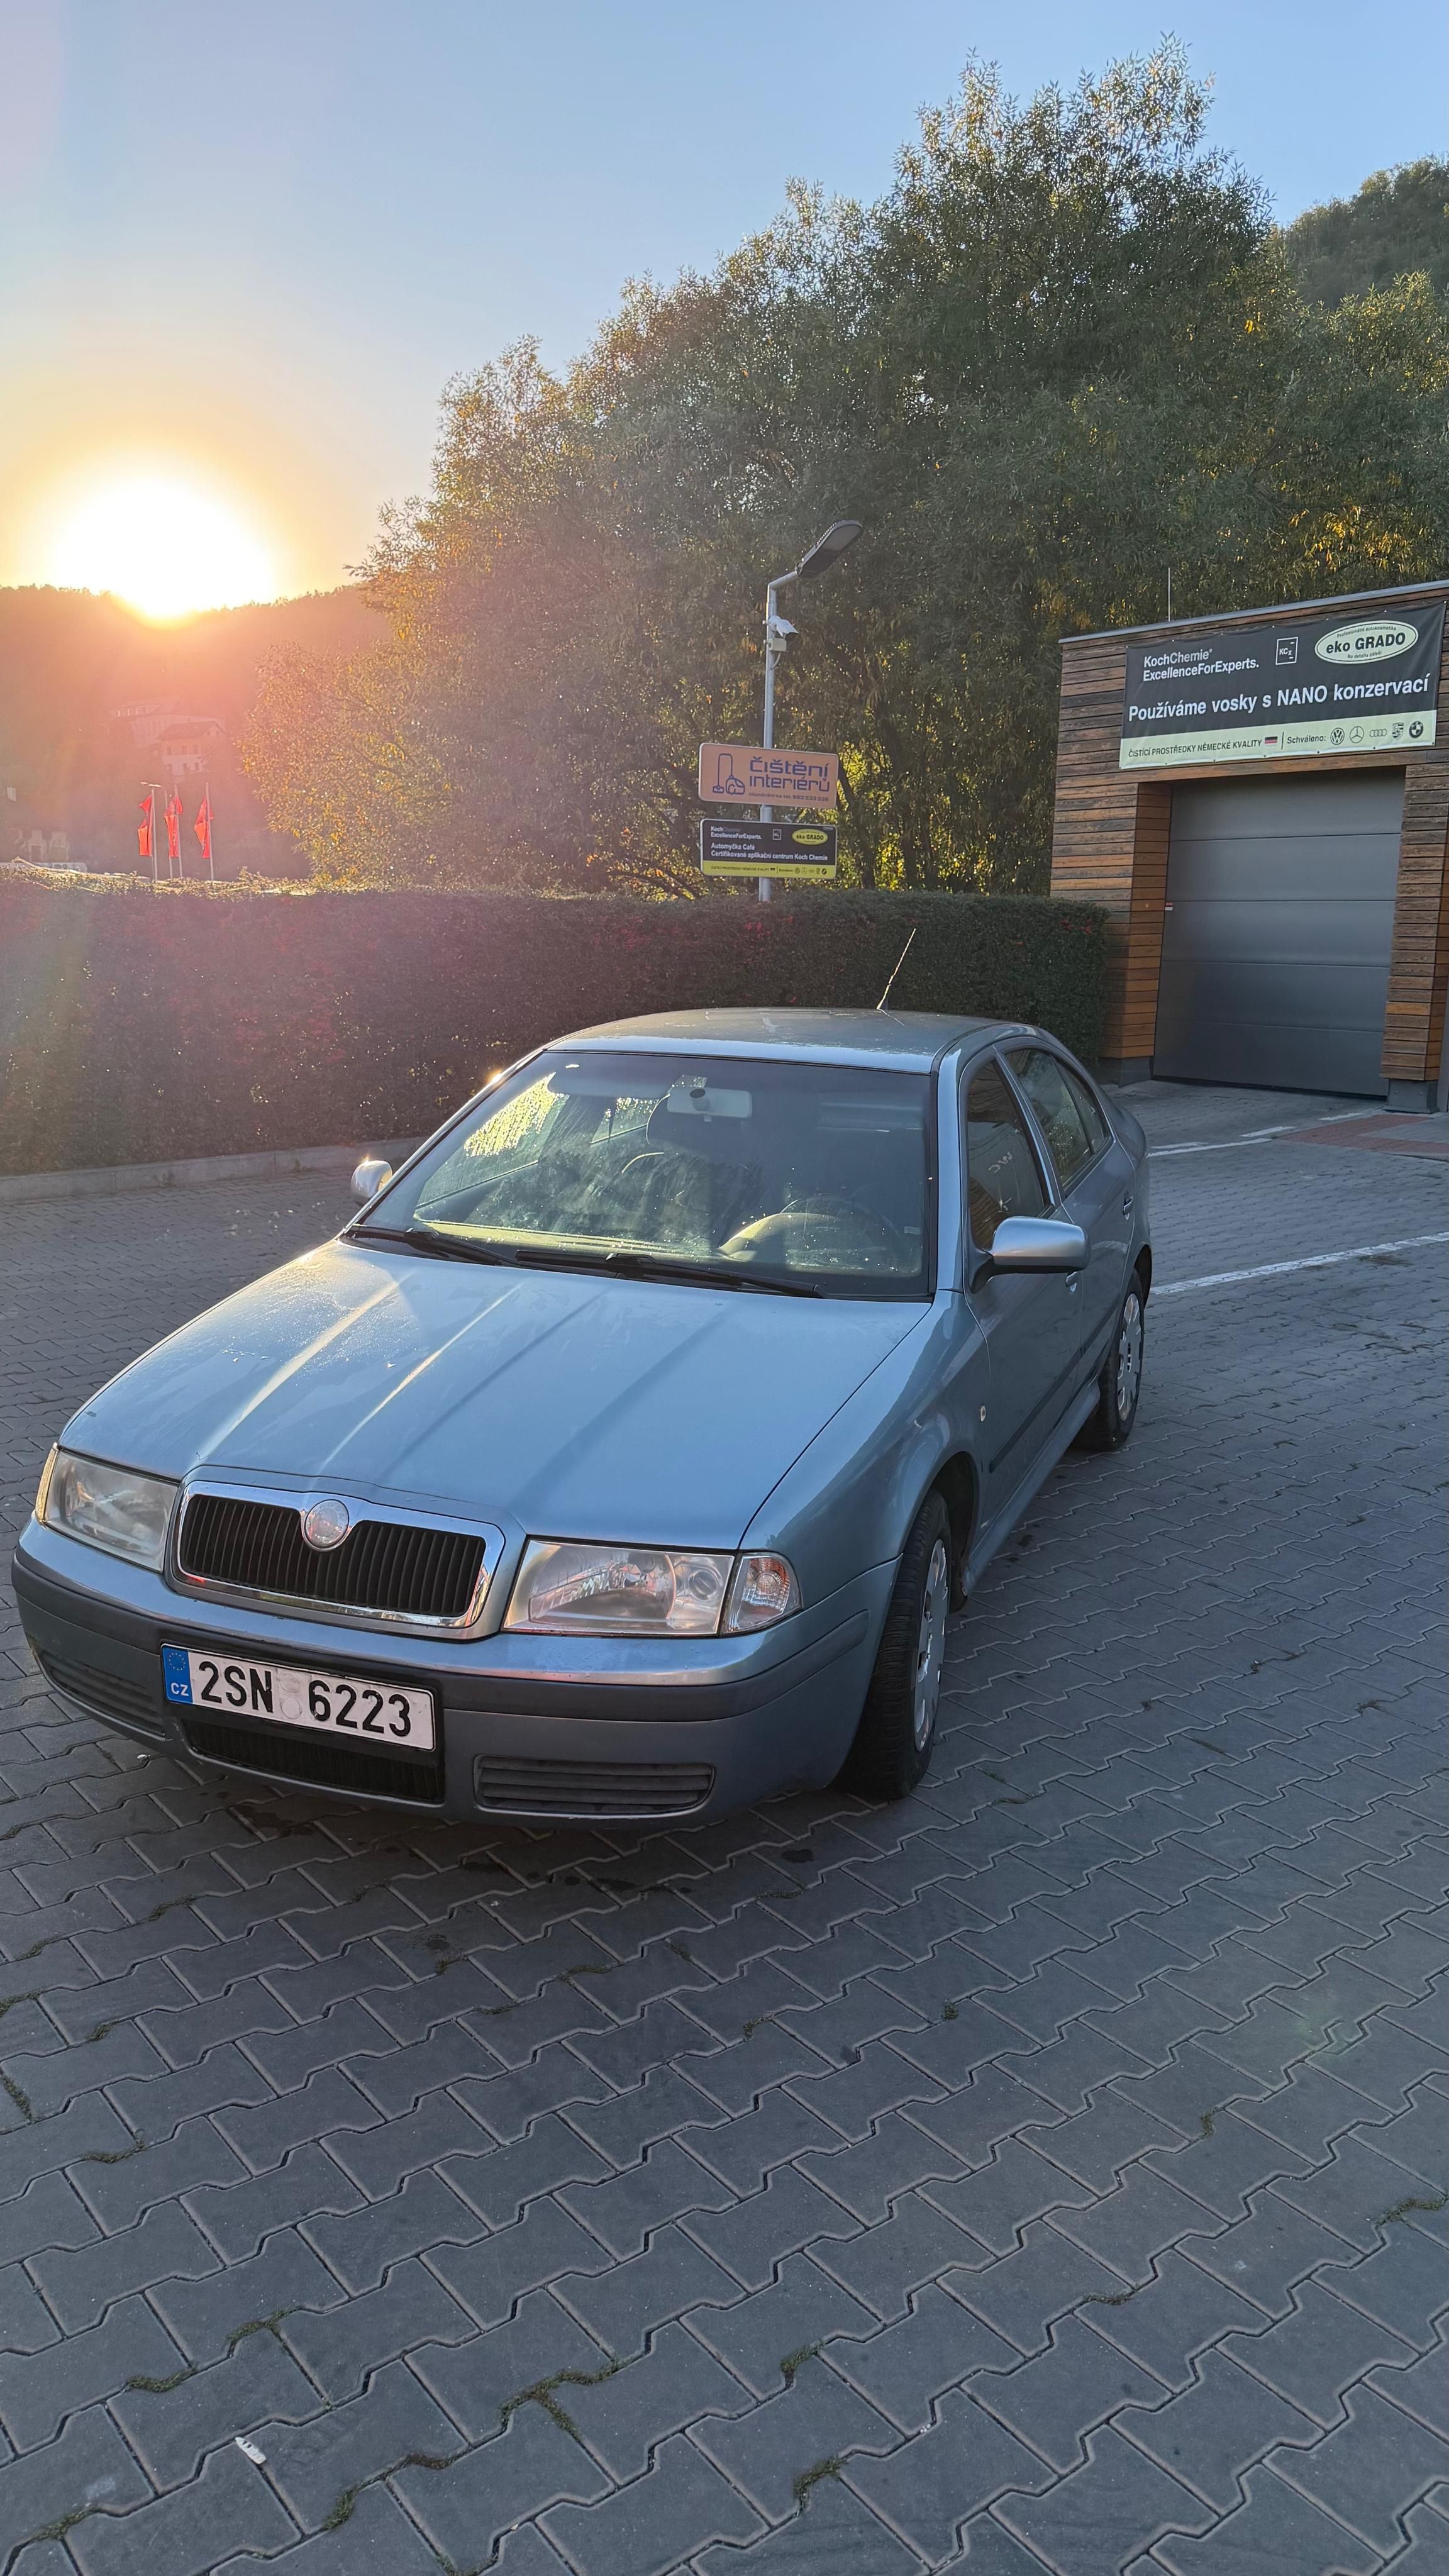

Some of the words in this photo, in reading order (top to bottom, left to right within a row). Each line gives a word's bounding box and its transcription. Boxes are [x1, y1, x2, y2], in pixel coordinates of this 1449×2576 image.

[1326, 640, 1350, 654] eko
[1355, 632, 1406, 650] GRADO
[1143, 658, 1259, 682] ExcellenceForExperts.
[1129, 700, 1207, 721] Používáme
[1211, 694, 1258, 714] vosky
[1262, 694, 1272, 708] s
[1277, 686, 1328, 706] NANO
[1333, 673, 1431, 701] konzervací
[1128, 748, 1150, 758] ČISTÍCÍ
[1152, 743, 1196, 755] PROSTŘEDKY
[1197, 740, 1231, 752] NĚMECKÉ
[1233, 739, 1263, 749] KVALITY
[1287, 735, 1326, 745] Schváleno:
[171, 1682, 189, 1697] CZ
[198, 1660, 274, 1713] 2SN
[308, 1680, 411, 1737] 6223
